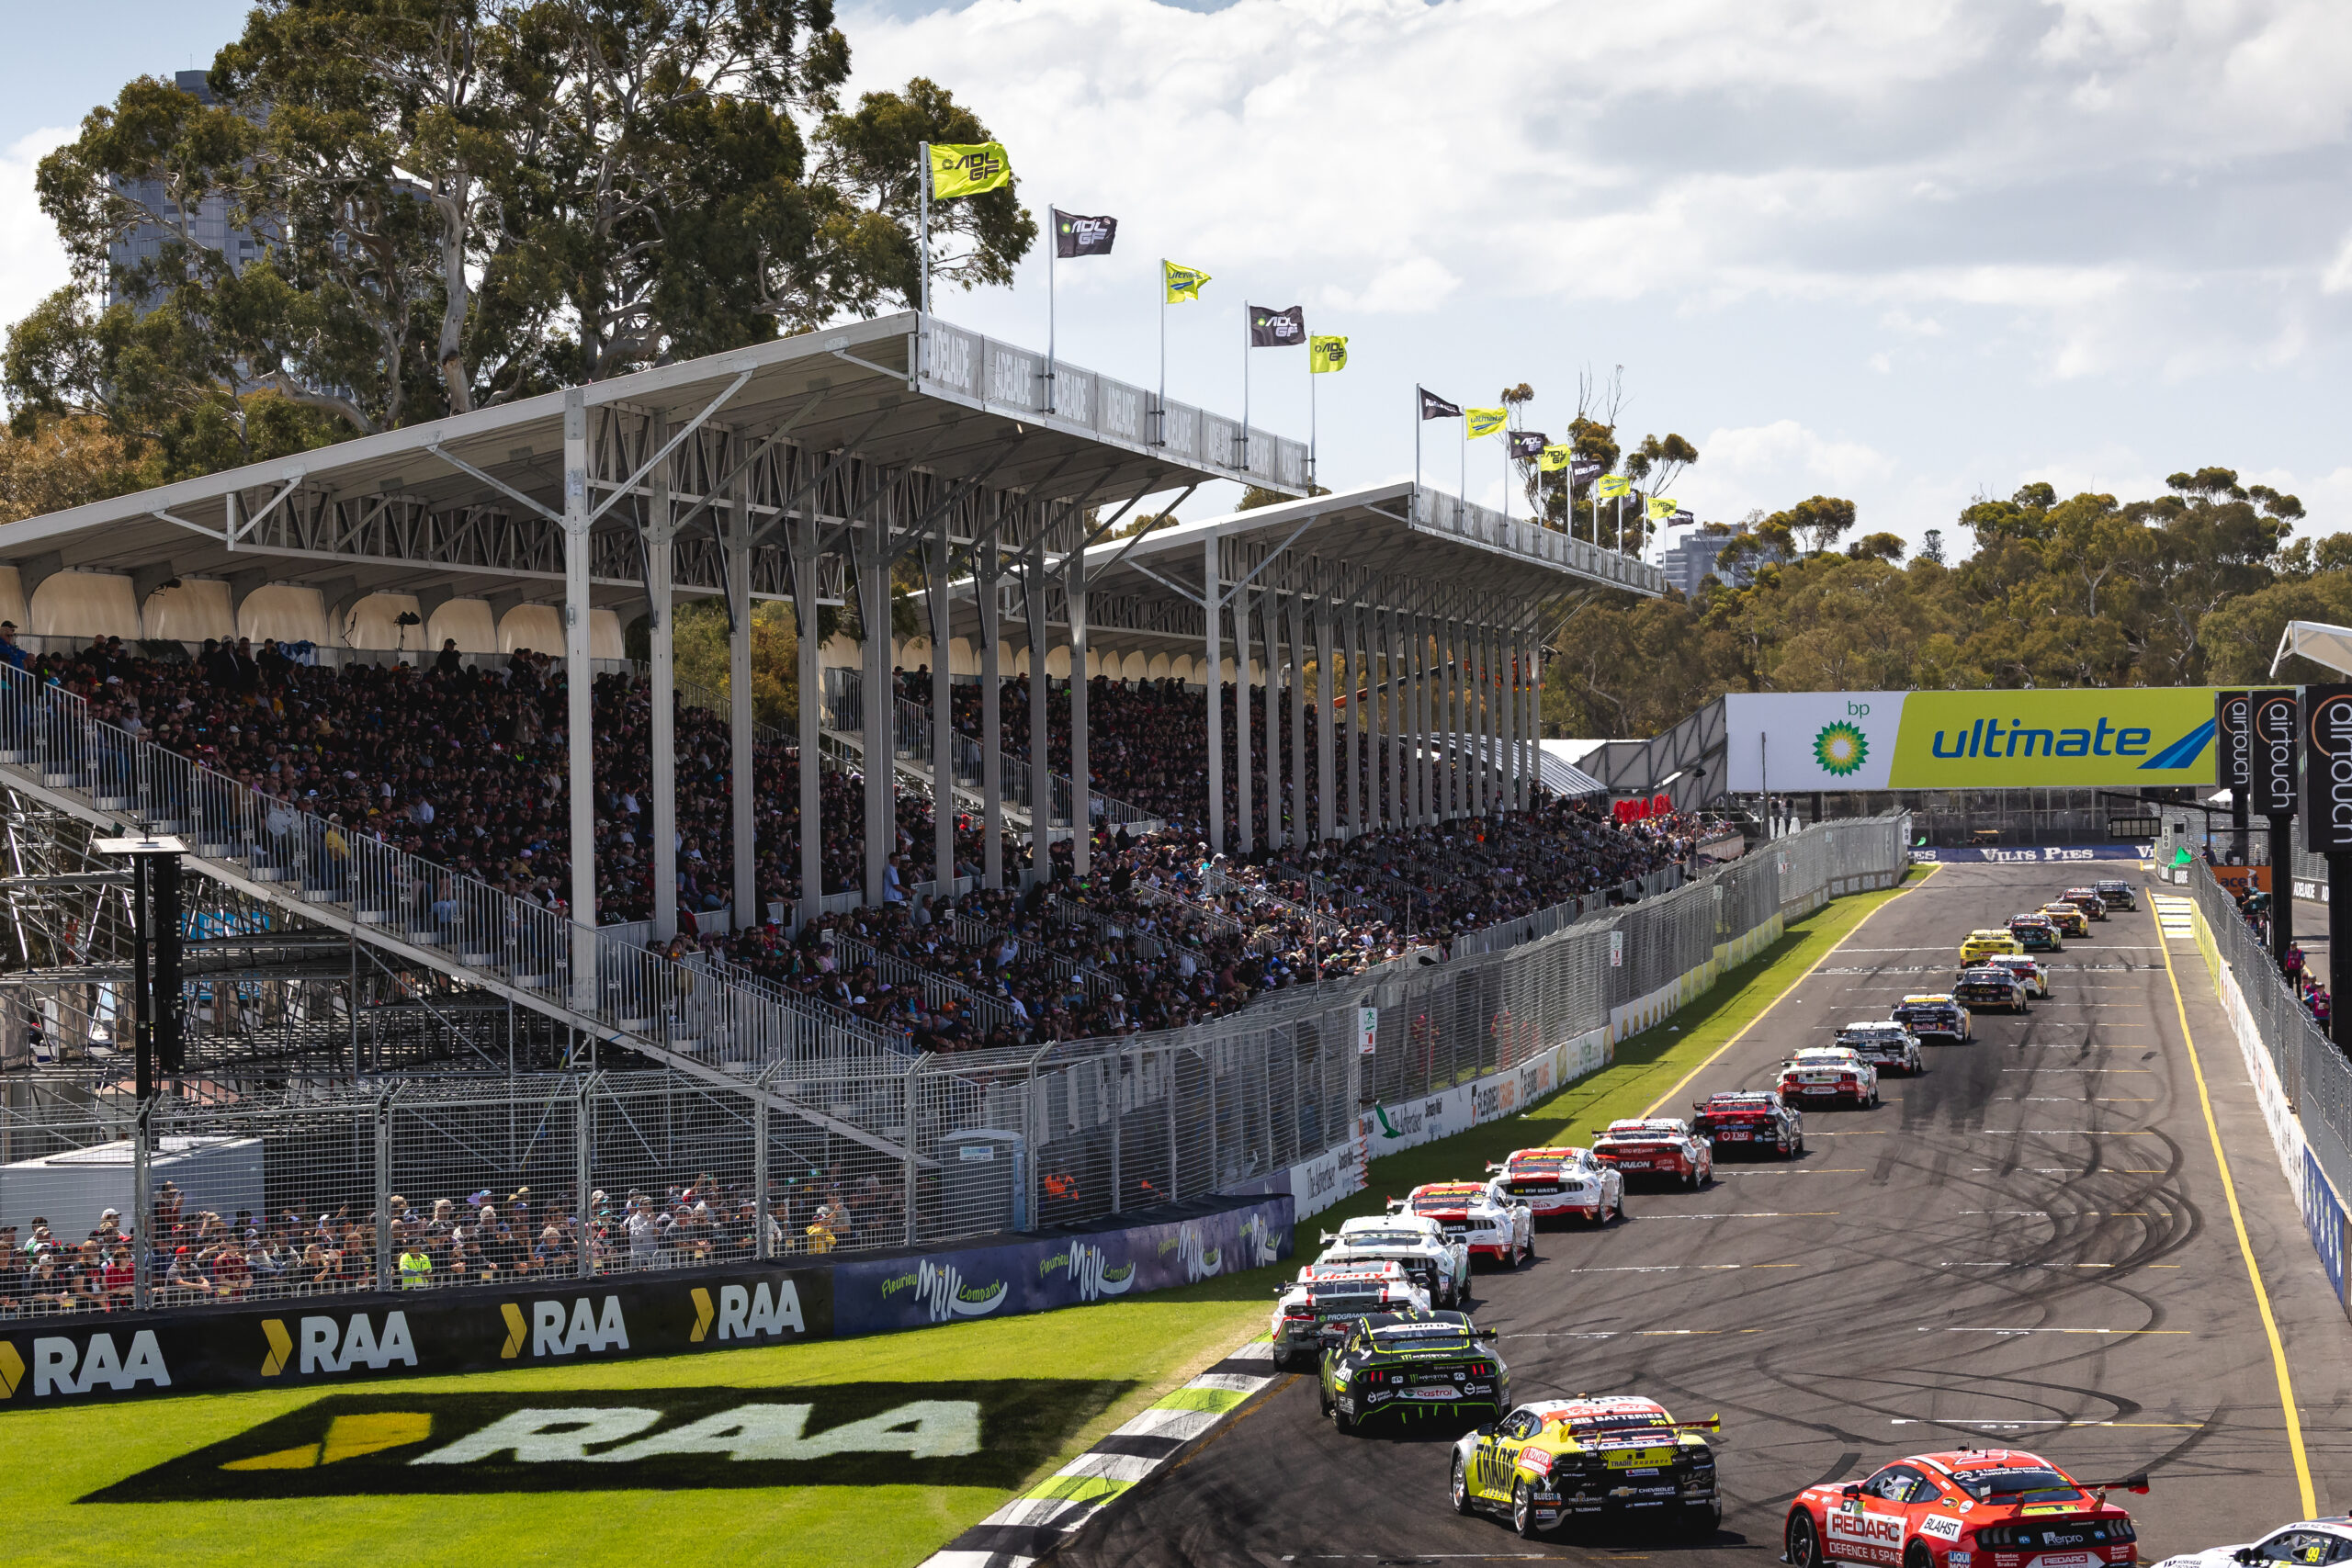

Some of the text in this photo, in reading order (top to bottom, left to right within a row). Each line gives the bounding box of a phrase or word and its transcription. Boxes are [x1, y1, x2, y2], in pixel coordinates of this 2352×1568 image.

[929, 327, 969, 389] ADELAIDE
[994, 350, 1032, 407] ADELAIDE
[1847, 700, 1871, 719] bp
[1931, 716, 2152, 759] ultimate
[2232, 702, 2251, 784] airtouch
[2269, 704, 2297, 808] airtouch
[2043, 847, 2094, 860] PIES
[1619, 1160, 1651, 1169] NULON
[1177, 1224, 1222, 1284] Milk
[1068, 1240, 1136, 1302] Milk
[1312, 1270, 1385, 1281] Liberty
[881, 1258, 1008, 1323] Fleurieu Milk Company
[718, 1280, 805, 1340] RAA
[533, 1295, 630, 1357] RAA
[300, 1310, 418, 1374] RAA
[34, 1329, 172, 1396] RAA
[1416, 1389, 1453, 1397] Castrol
[1594, 1413, 1663, 1422] BATTERIES
[407, 1399, 982, 1465] RAA
[1529, 1447, 1551, 1466] TOYOTA
[1610, 1460, 1634, 1468] TRADIE
[1832, 1513, 1900, 1543] REDARC
[1923, 1517, 1959, 1537] BLAHST
[2042, 1531, 2084, 1545] Aerpro
[1829, 1541, 1903, 1564] DEFENCE & SPACE
[1949, 1551, 1971, 1563] LIQUI
[2043, 1555, 2086, 1565] REDARC
[2306, 1547, 2320, 1562] 99
